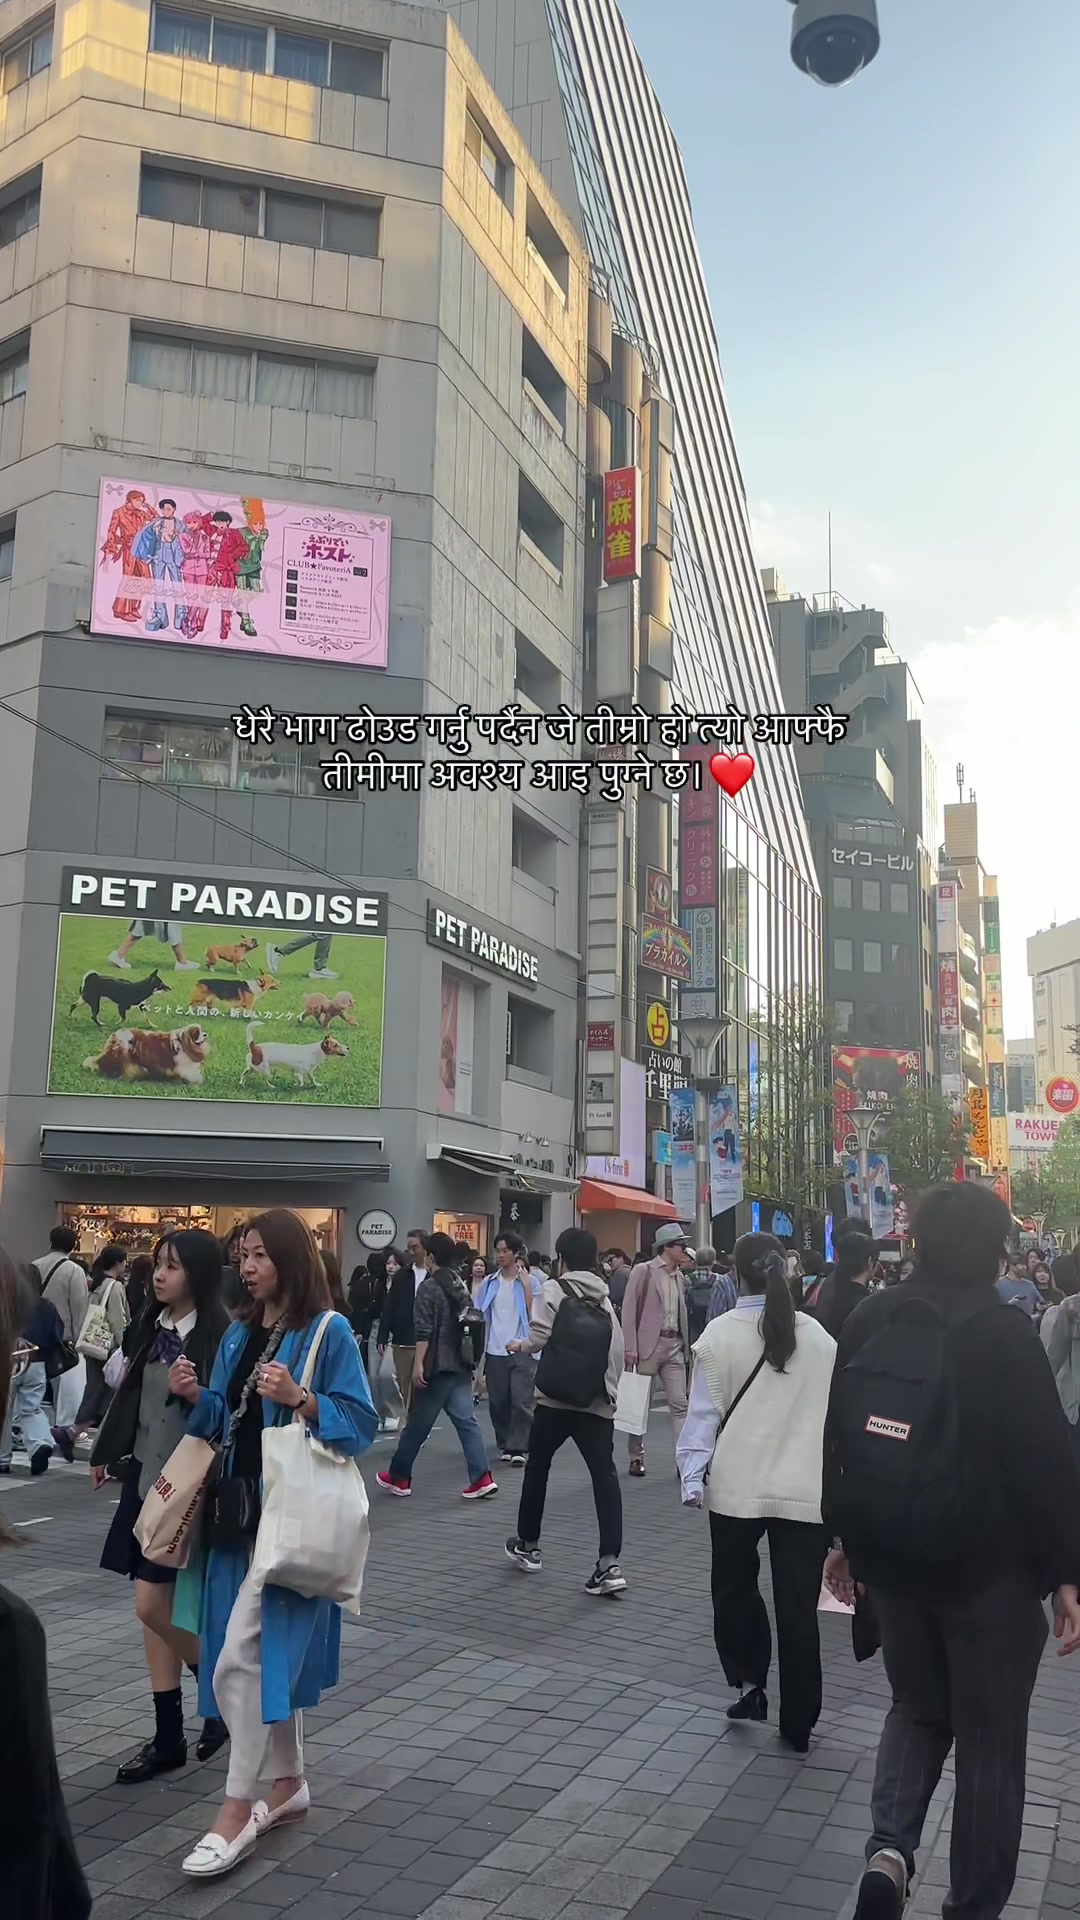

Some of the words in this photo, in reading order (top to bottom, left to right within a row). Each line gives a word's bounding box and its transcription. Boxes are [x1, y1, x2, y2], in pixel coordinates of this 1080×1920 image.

[607, 497, 632, 559] 麻雀
[308, 534, 349, 547] えぶりでい
[303, 543, 351, 563] ホスト
[831, 847, 915, 871] セイコービル
[71, 874, 157, 911] PET
[170, 881, 380, 928] PARADISE
[435, 908, 468, 948] PET
[470, 925, 539, 983] PARADISE
[142, 1003, 307, 1022] ペットと人間の、新しいカンケイ
[648, 1050, 682, 1074] 占いの館
[1015, 1118, 1062, 1131] RAKUE
[454, 1232, 474, 1240] FREE
[456, 1224, 473, 1232] TAX
[869, 1420, 907, 1435] HUNTER
